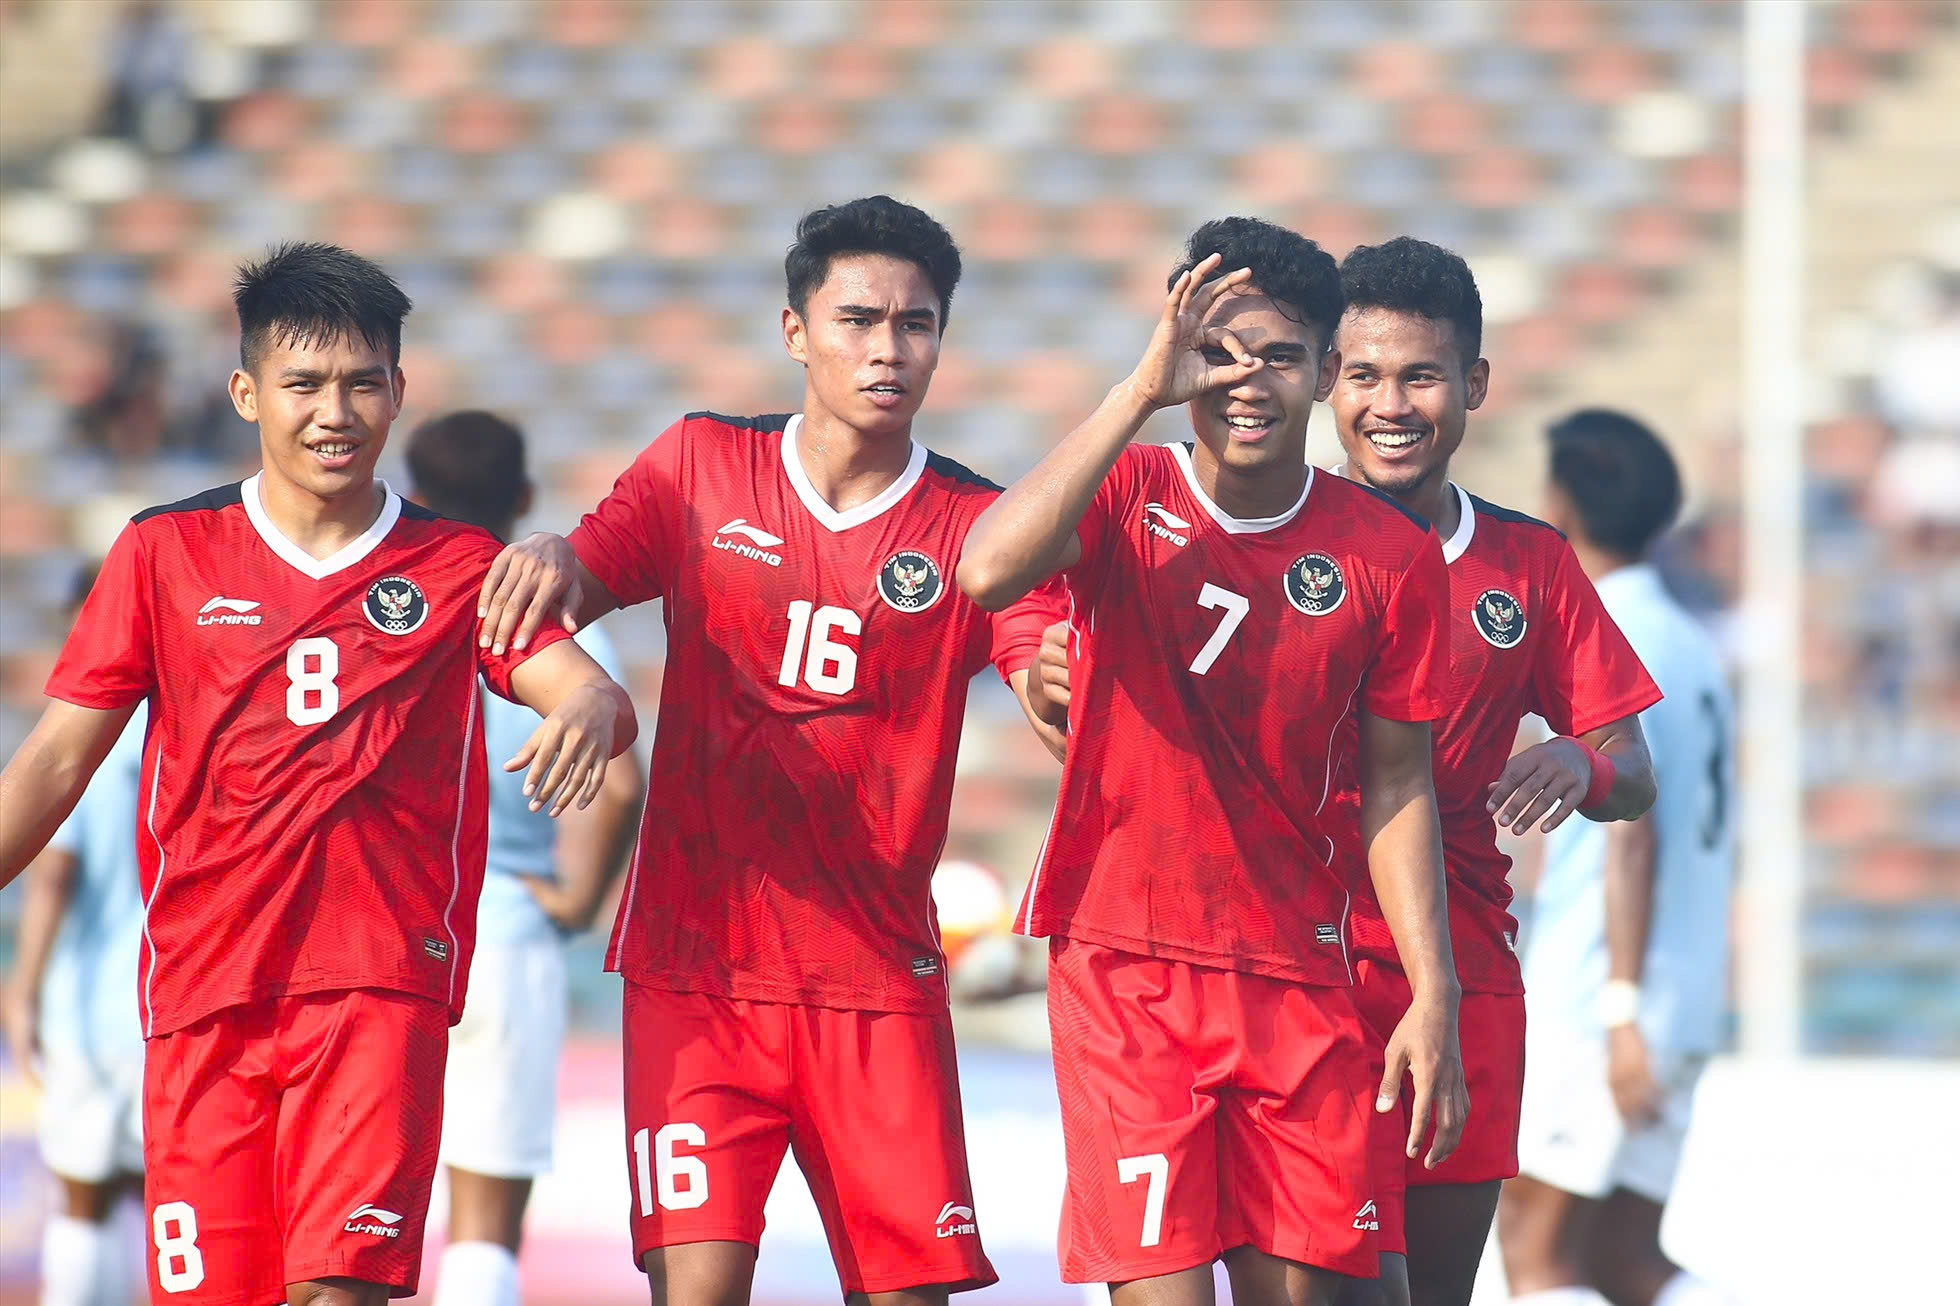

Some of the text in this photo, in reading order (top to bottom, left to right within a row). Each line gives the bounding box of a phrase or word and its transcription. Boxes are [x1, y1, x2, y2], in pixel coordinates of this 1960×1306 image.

[712, 535, 783, 567] LI-NING
[884, 551, 938, 576] TIM INDONESIA
[1292, 554, 1342, 582] TIM INDONESIA
[368, 577, 422, 598] TIM INDONESIA
[197, 614, 262, 626] LI-NING
[778, 600, 862, 695] 16
[1189, 582, 1250, 675] 7
[286, 637, 339, 727] 8
[633, 1122, 709, 1217] 16
[1116, 1153, 1169, 1247] 7
[152, 1201, 205, 1293] 8
[344, 1222, 400, 1238] LI-NING
